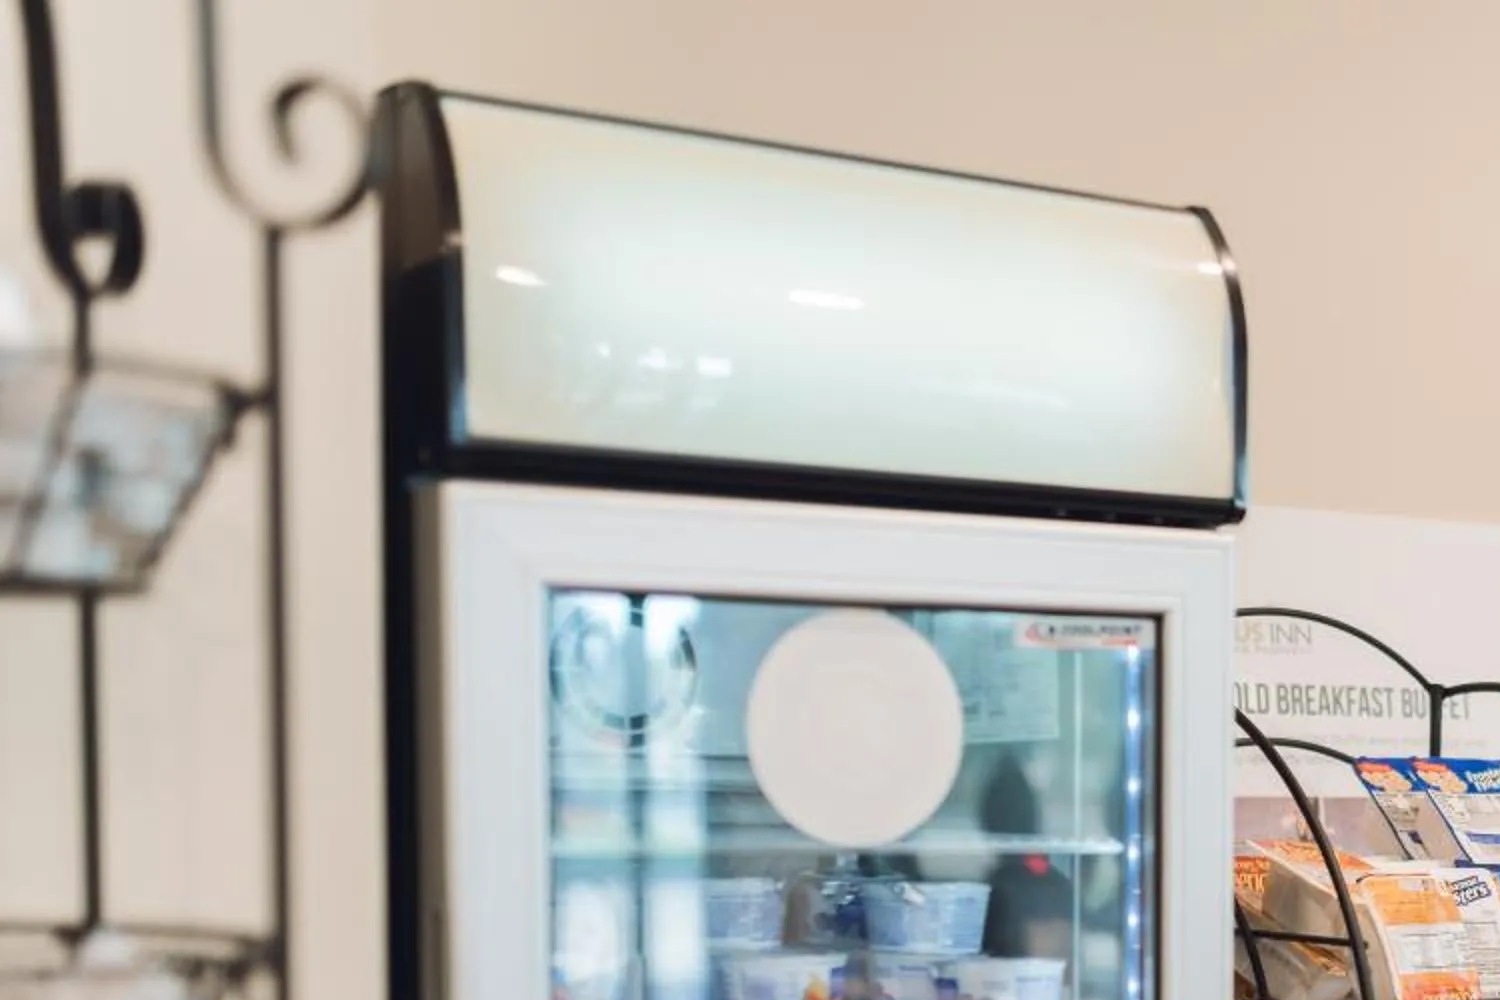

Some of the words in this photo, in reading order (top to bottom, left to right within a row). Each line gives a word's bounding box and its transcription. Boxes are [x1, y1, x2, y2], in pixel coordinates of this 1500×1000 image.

[1269, 622, 1313, 645] INN
[1276, 683, 1394, 719] BREAKFAST
[1401, 687, 1470, 720] BUET
